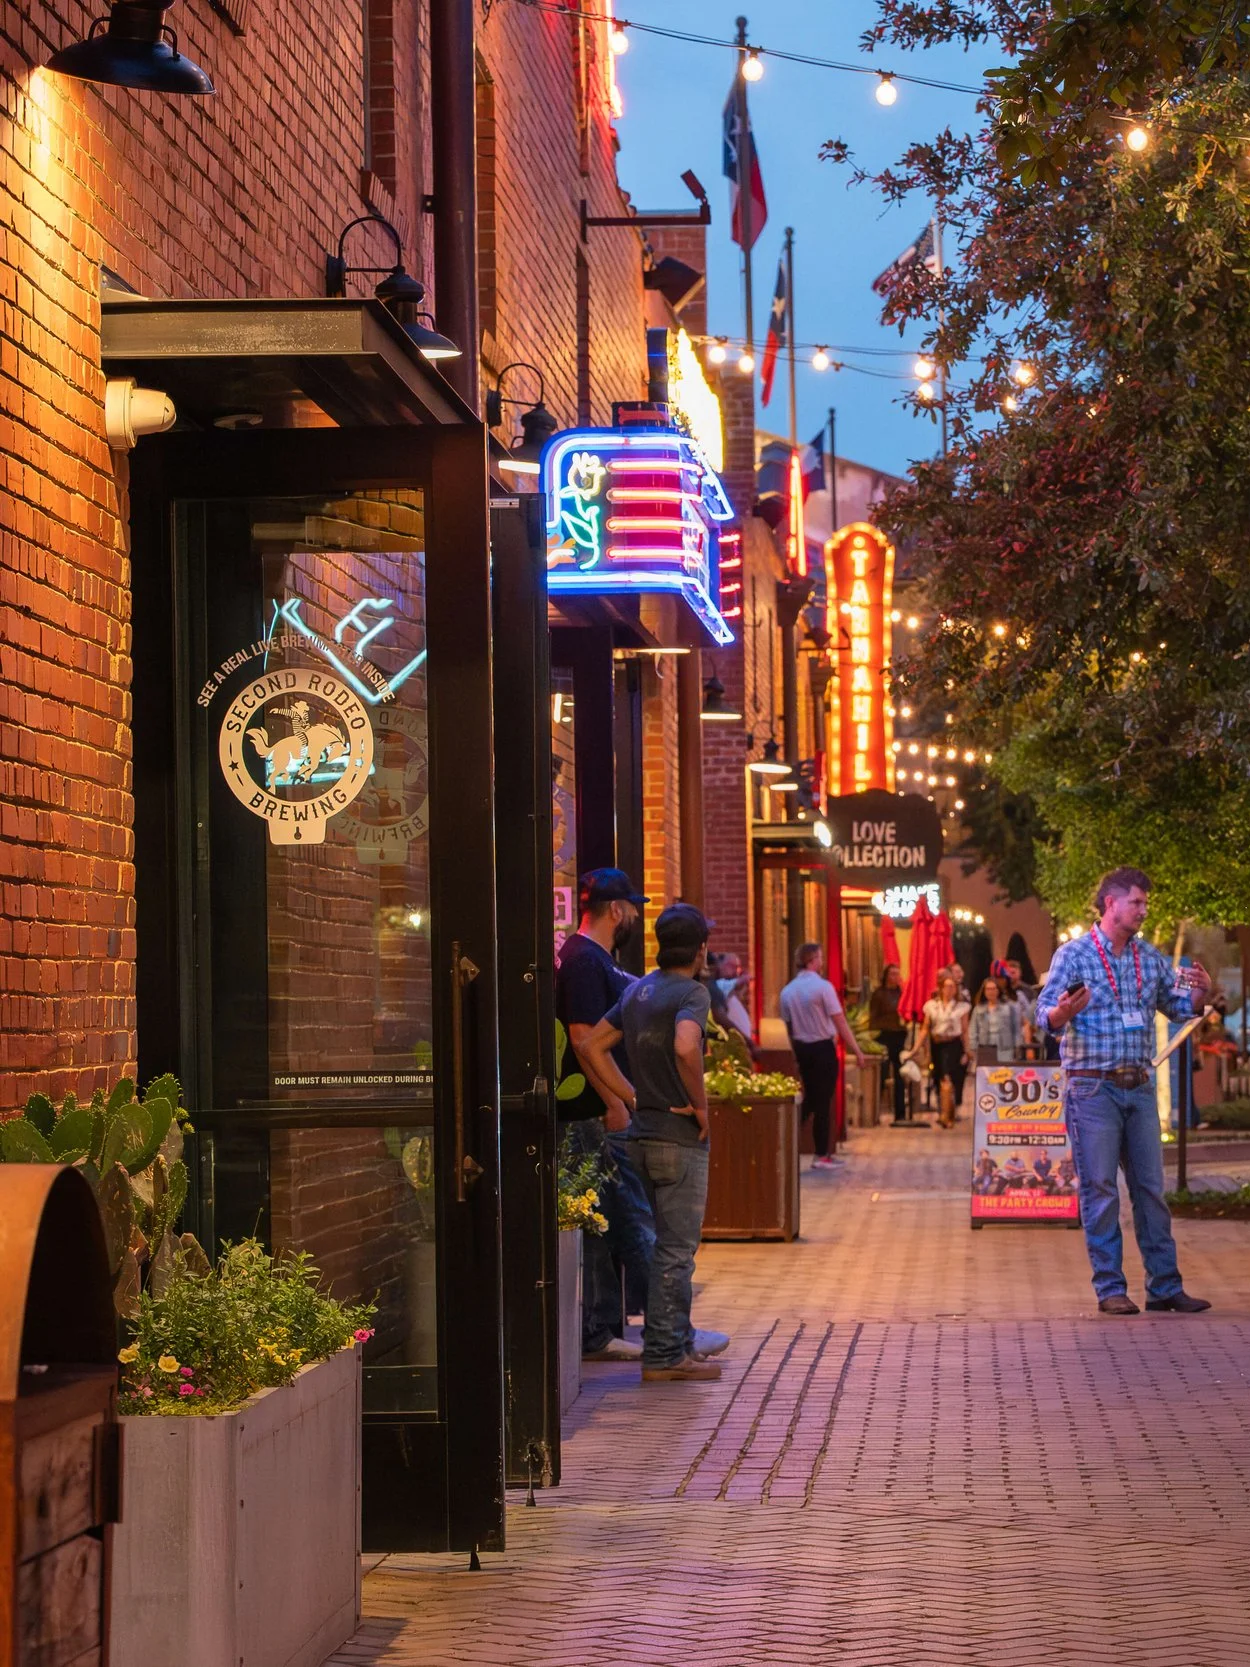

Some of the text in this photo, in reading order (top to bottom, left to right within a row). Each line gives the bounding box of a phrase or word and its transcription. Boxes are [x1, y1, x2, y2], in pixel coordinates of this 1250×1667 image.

[197, 680, 219, 708] SEE
[213, 671, 226, 684] A
[221, 648, 253, 675] REAL
[251, 637, 279, 657] LIVE
[362, 661, 396, 704] INSIDE
[227, 672, 366, 733] SECOND RODEO
[249, 788, 347, 822] BREWING
[852, 821, 897, 843] LOVE
[831, 844, 926, 869] OLLECTION
[274, 1077, 296, 1085] DOOR
[298, 1076, 320, 1085] MUST
[321, 1076, 352, 1084] REMAIN
[353, 1075, 393, 1084] UNLOCKED
[395, 1075, 424, 1083] DURING
[998, 1079, 1059, 1103] 90's
[1005, 1104, 1058, 1119] Country
[980, 1197, 998, 1208] THE
[1000, 1197, 1033, 1208] PARTY
